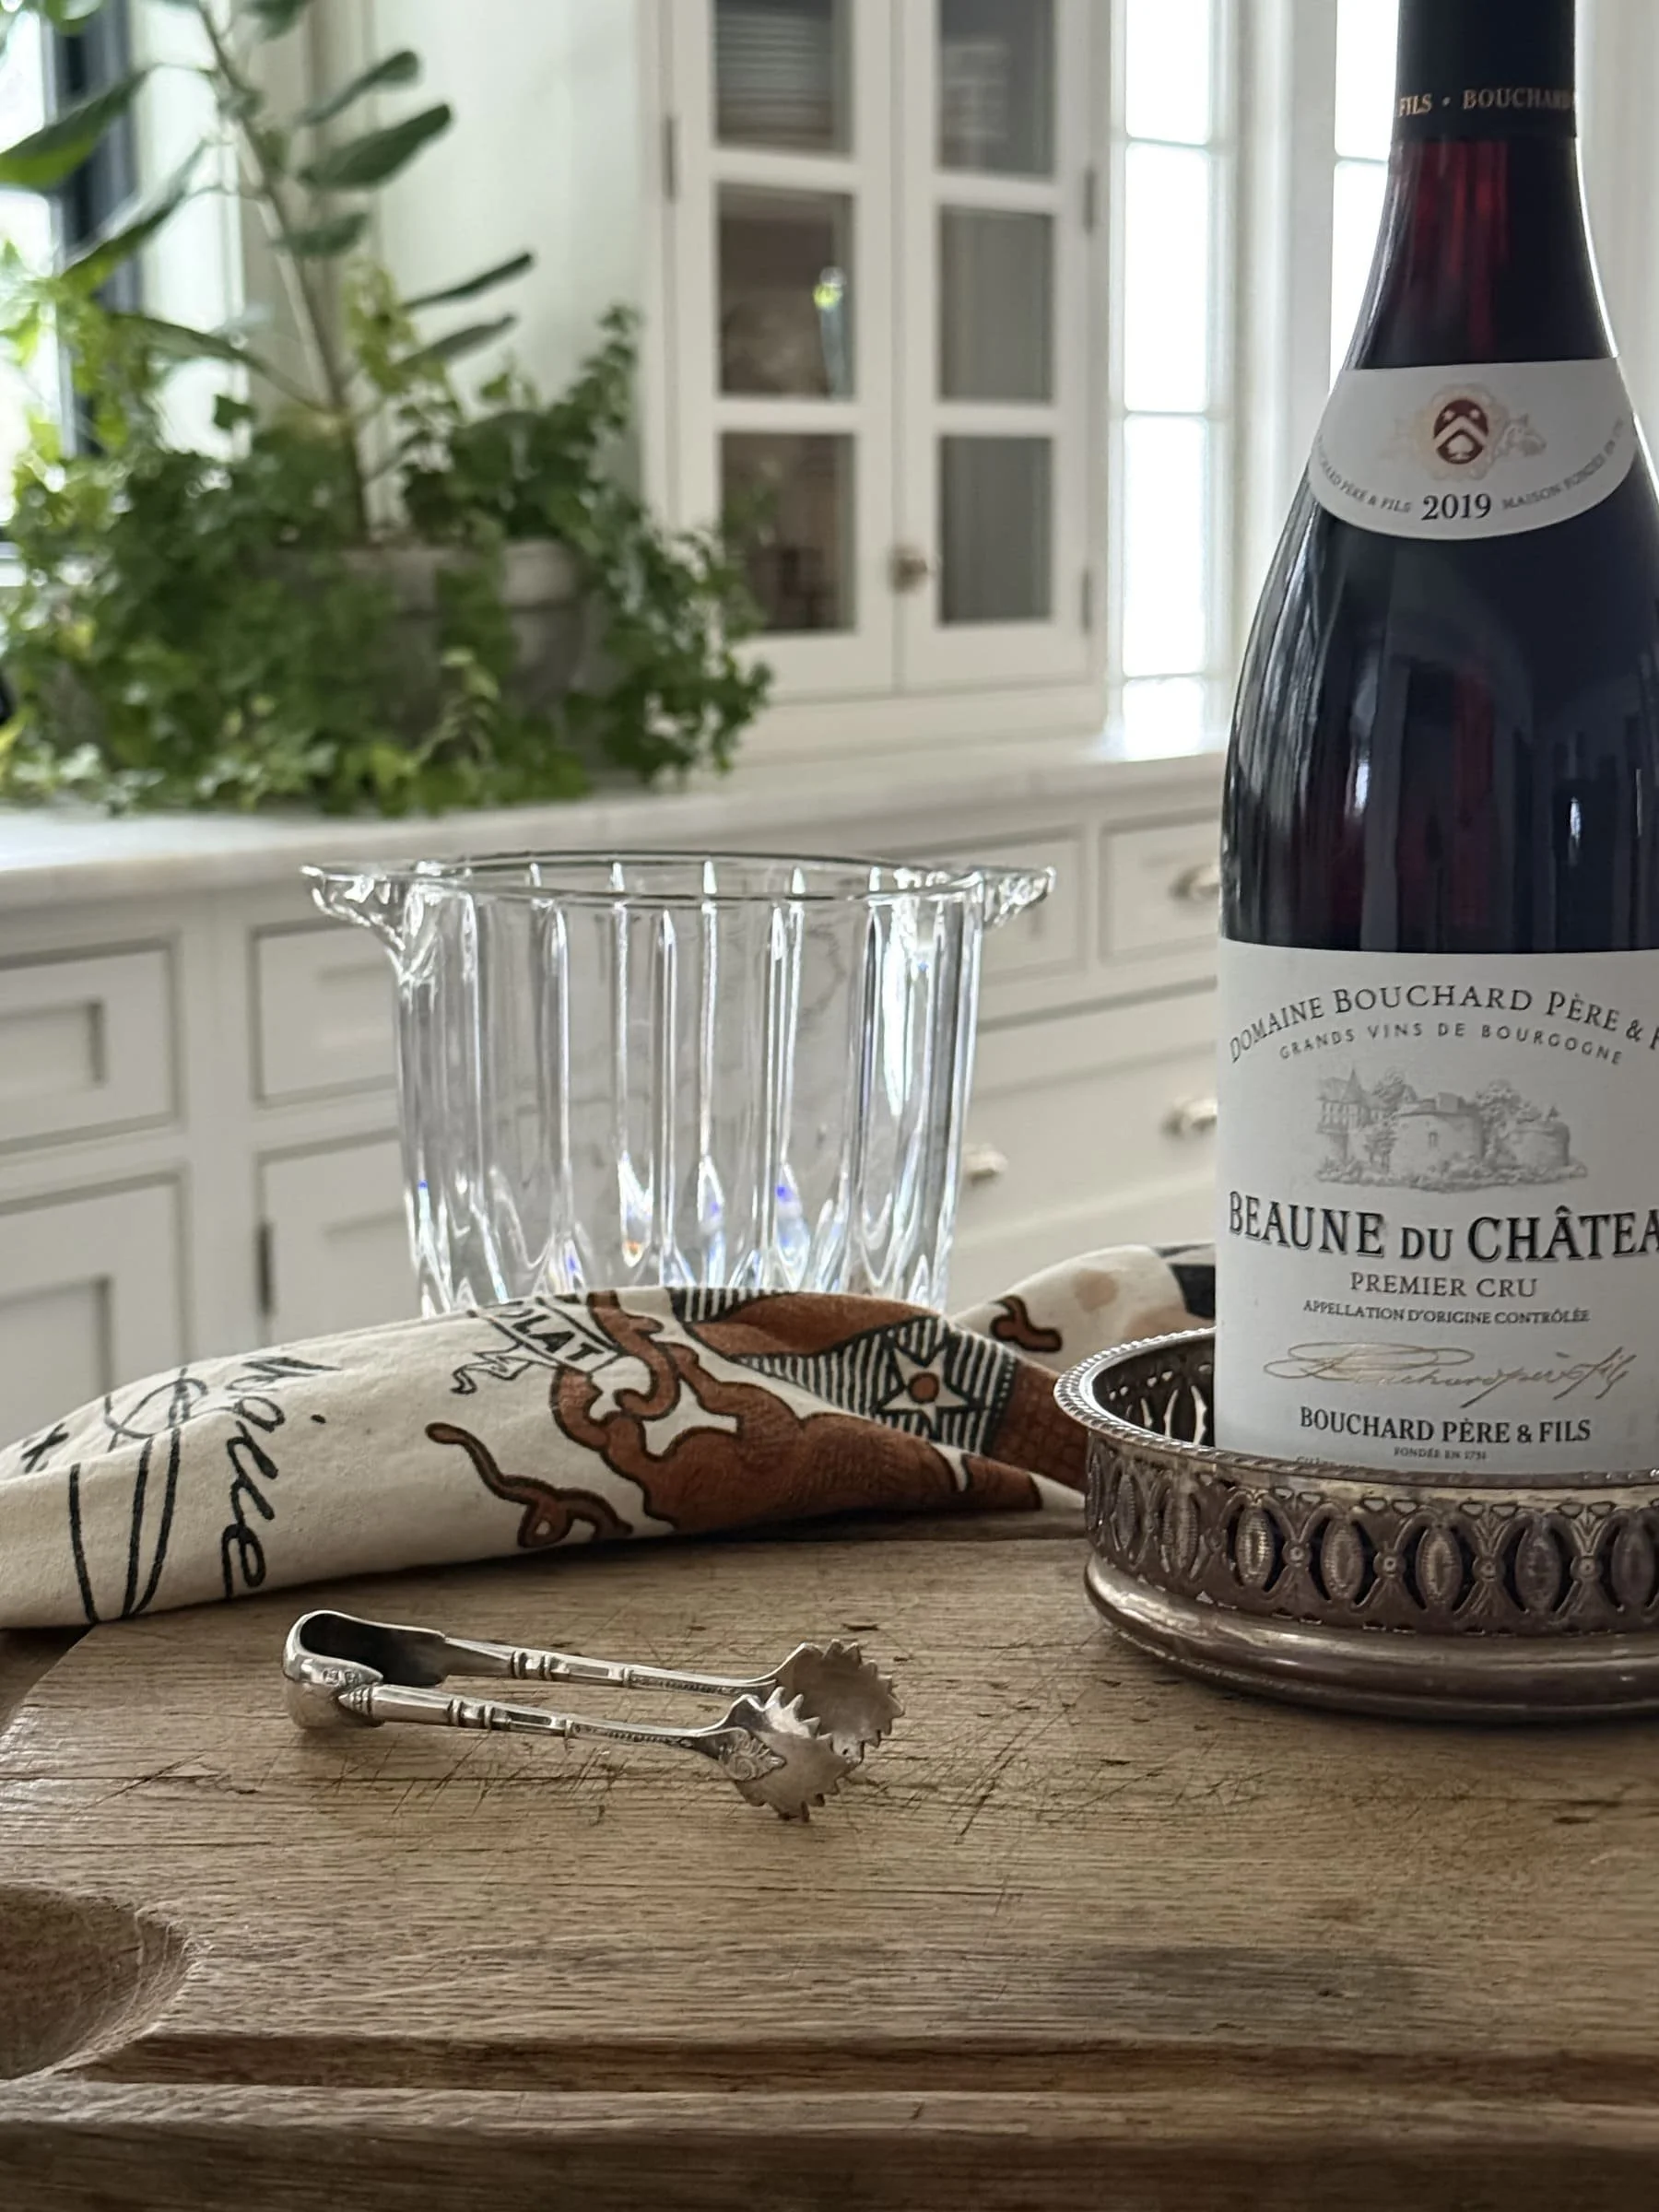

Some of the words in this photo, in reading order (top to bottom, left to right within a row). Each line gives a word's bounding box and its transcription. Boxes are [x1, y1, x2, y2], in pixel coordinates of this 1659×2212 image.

[1398, 93, 1432, 118] FILS
[1380, 497, 1412, 514] FILS
[1420, 493, 1491, 521] 2019
[1229, 996, 1324, 1065] DOMAINE
[1333, 985, 1534, 1015] BOUCHARD
[1547, 991, 1620, 1032] PÈRE
[1625, 1018, 1643, 1043] &
[1279, 1028, 1355, 1060] GRANDS
[1367, 1022, 1424, 1040] VINS
[1438, 1022, 1465, 1038] DE
[1481, 1025, 1623, 1066] BOURGOGNE
[1229, 1191, 1386, 1260] BEAUNE
[1399, 1226, 1453, 1261] DU
[1350, 1271, 1466, 1298] PREMIER
[1477, 1277, 1538, 1299] CRU
[1302, 1300, 1406, 1322] APPELLATION
[1300, 1406, 1435, 1442] BOUCHARD
[1441, 1417, 1511, 1443] PÈRE
[1516, 1425, 1534, 1443] &
[1539, 1419, 1591, 1442] FILS
